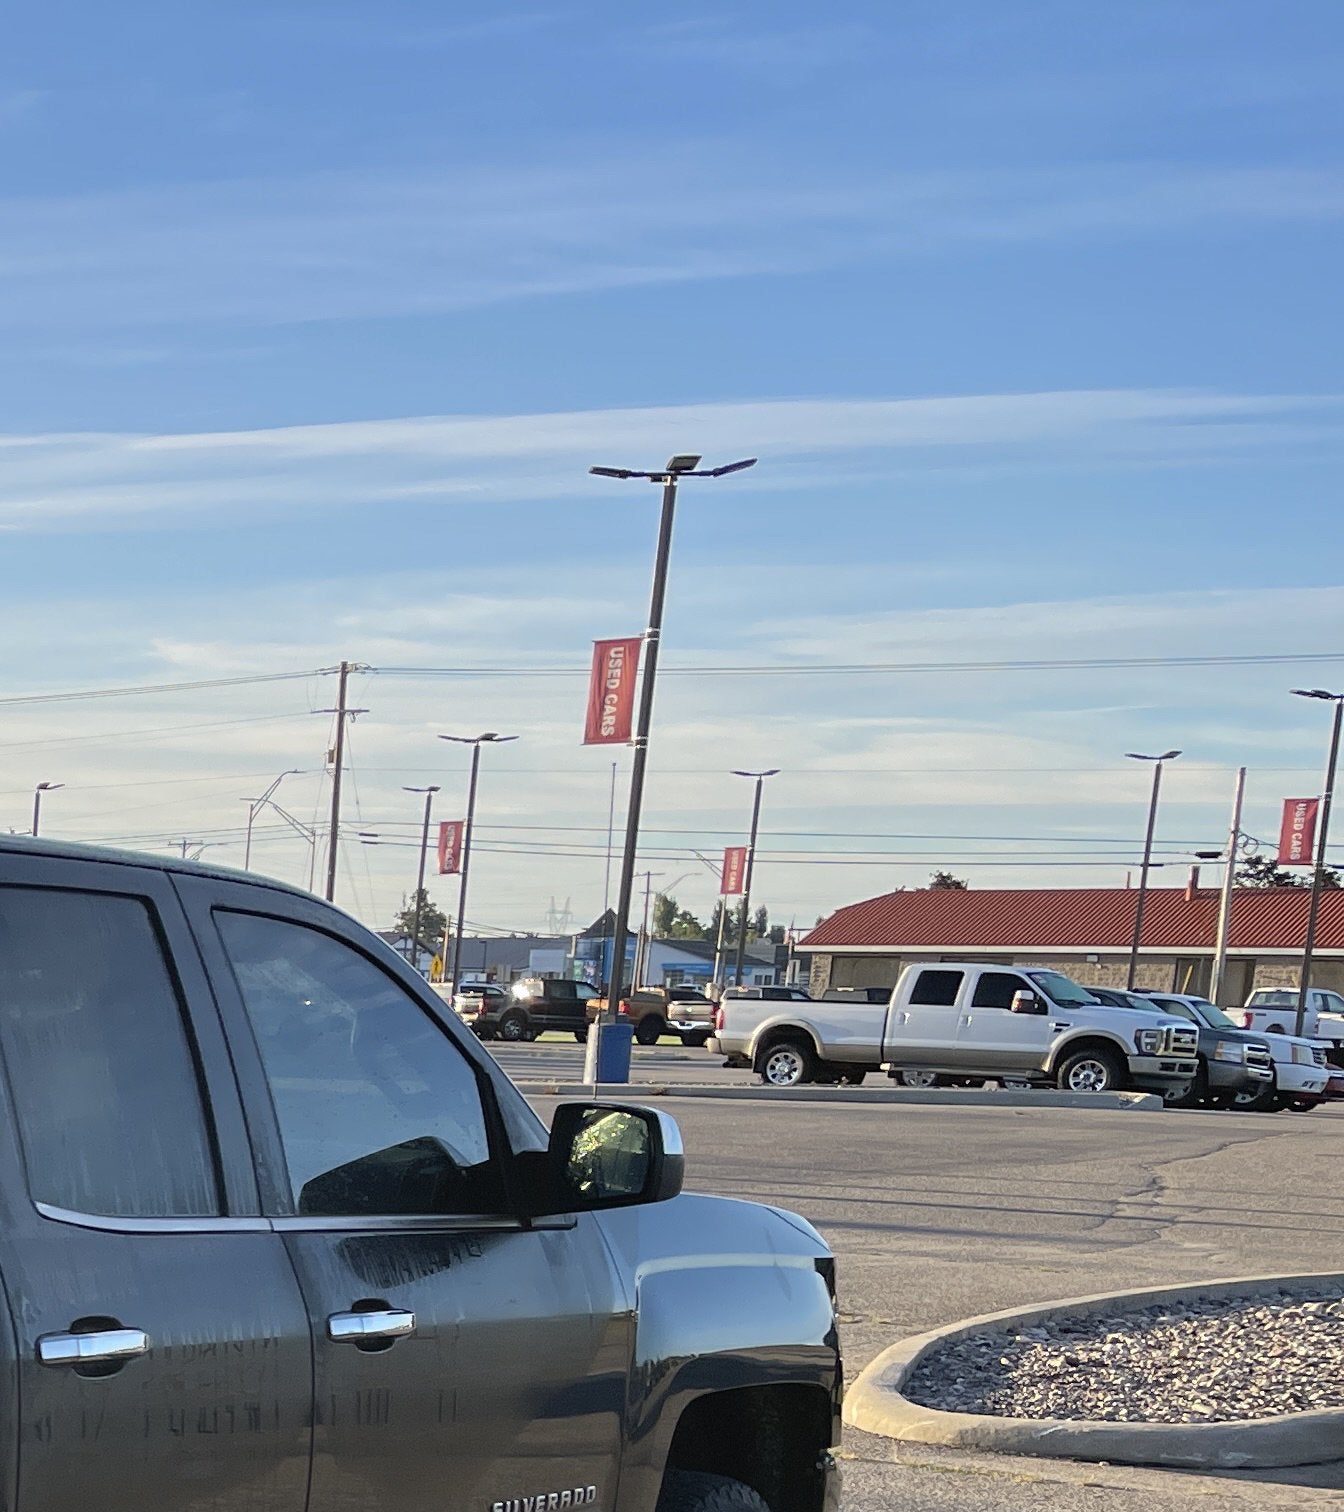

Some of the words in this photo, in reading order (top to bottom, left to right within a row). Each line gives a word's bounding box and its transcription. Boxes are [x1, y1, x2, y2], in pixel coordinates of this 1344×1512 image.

[605, 646, 625, 690] USED
[600, 693, 619, 737] CARS
[1293, 803, 1308, 831] USED
[1289, 832, 1303, 860] CARS
